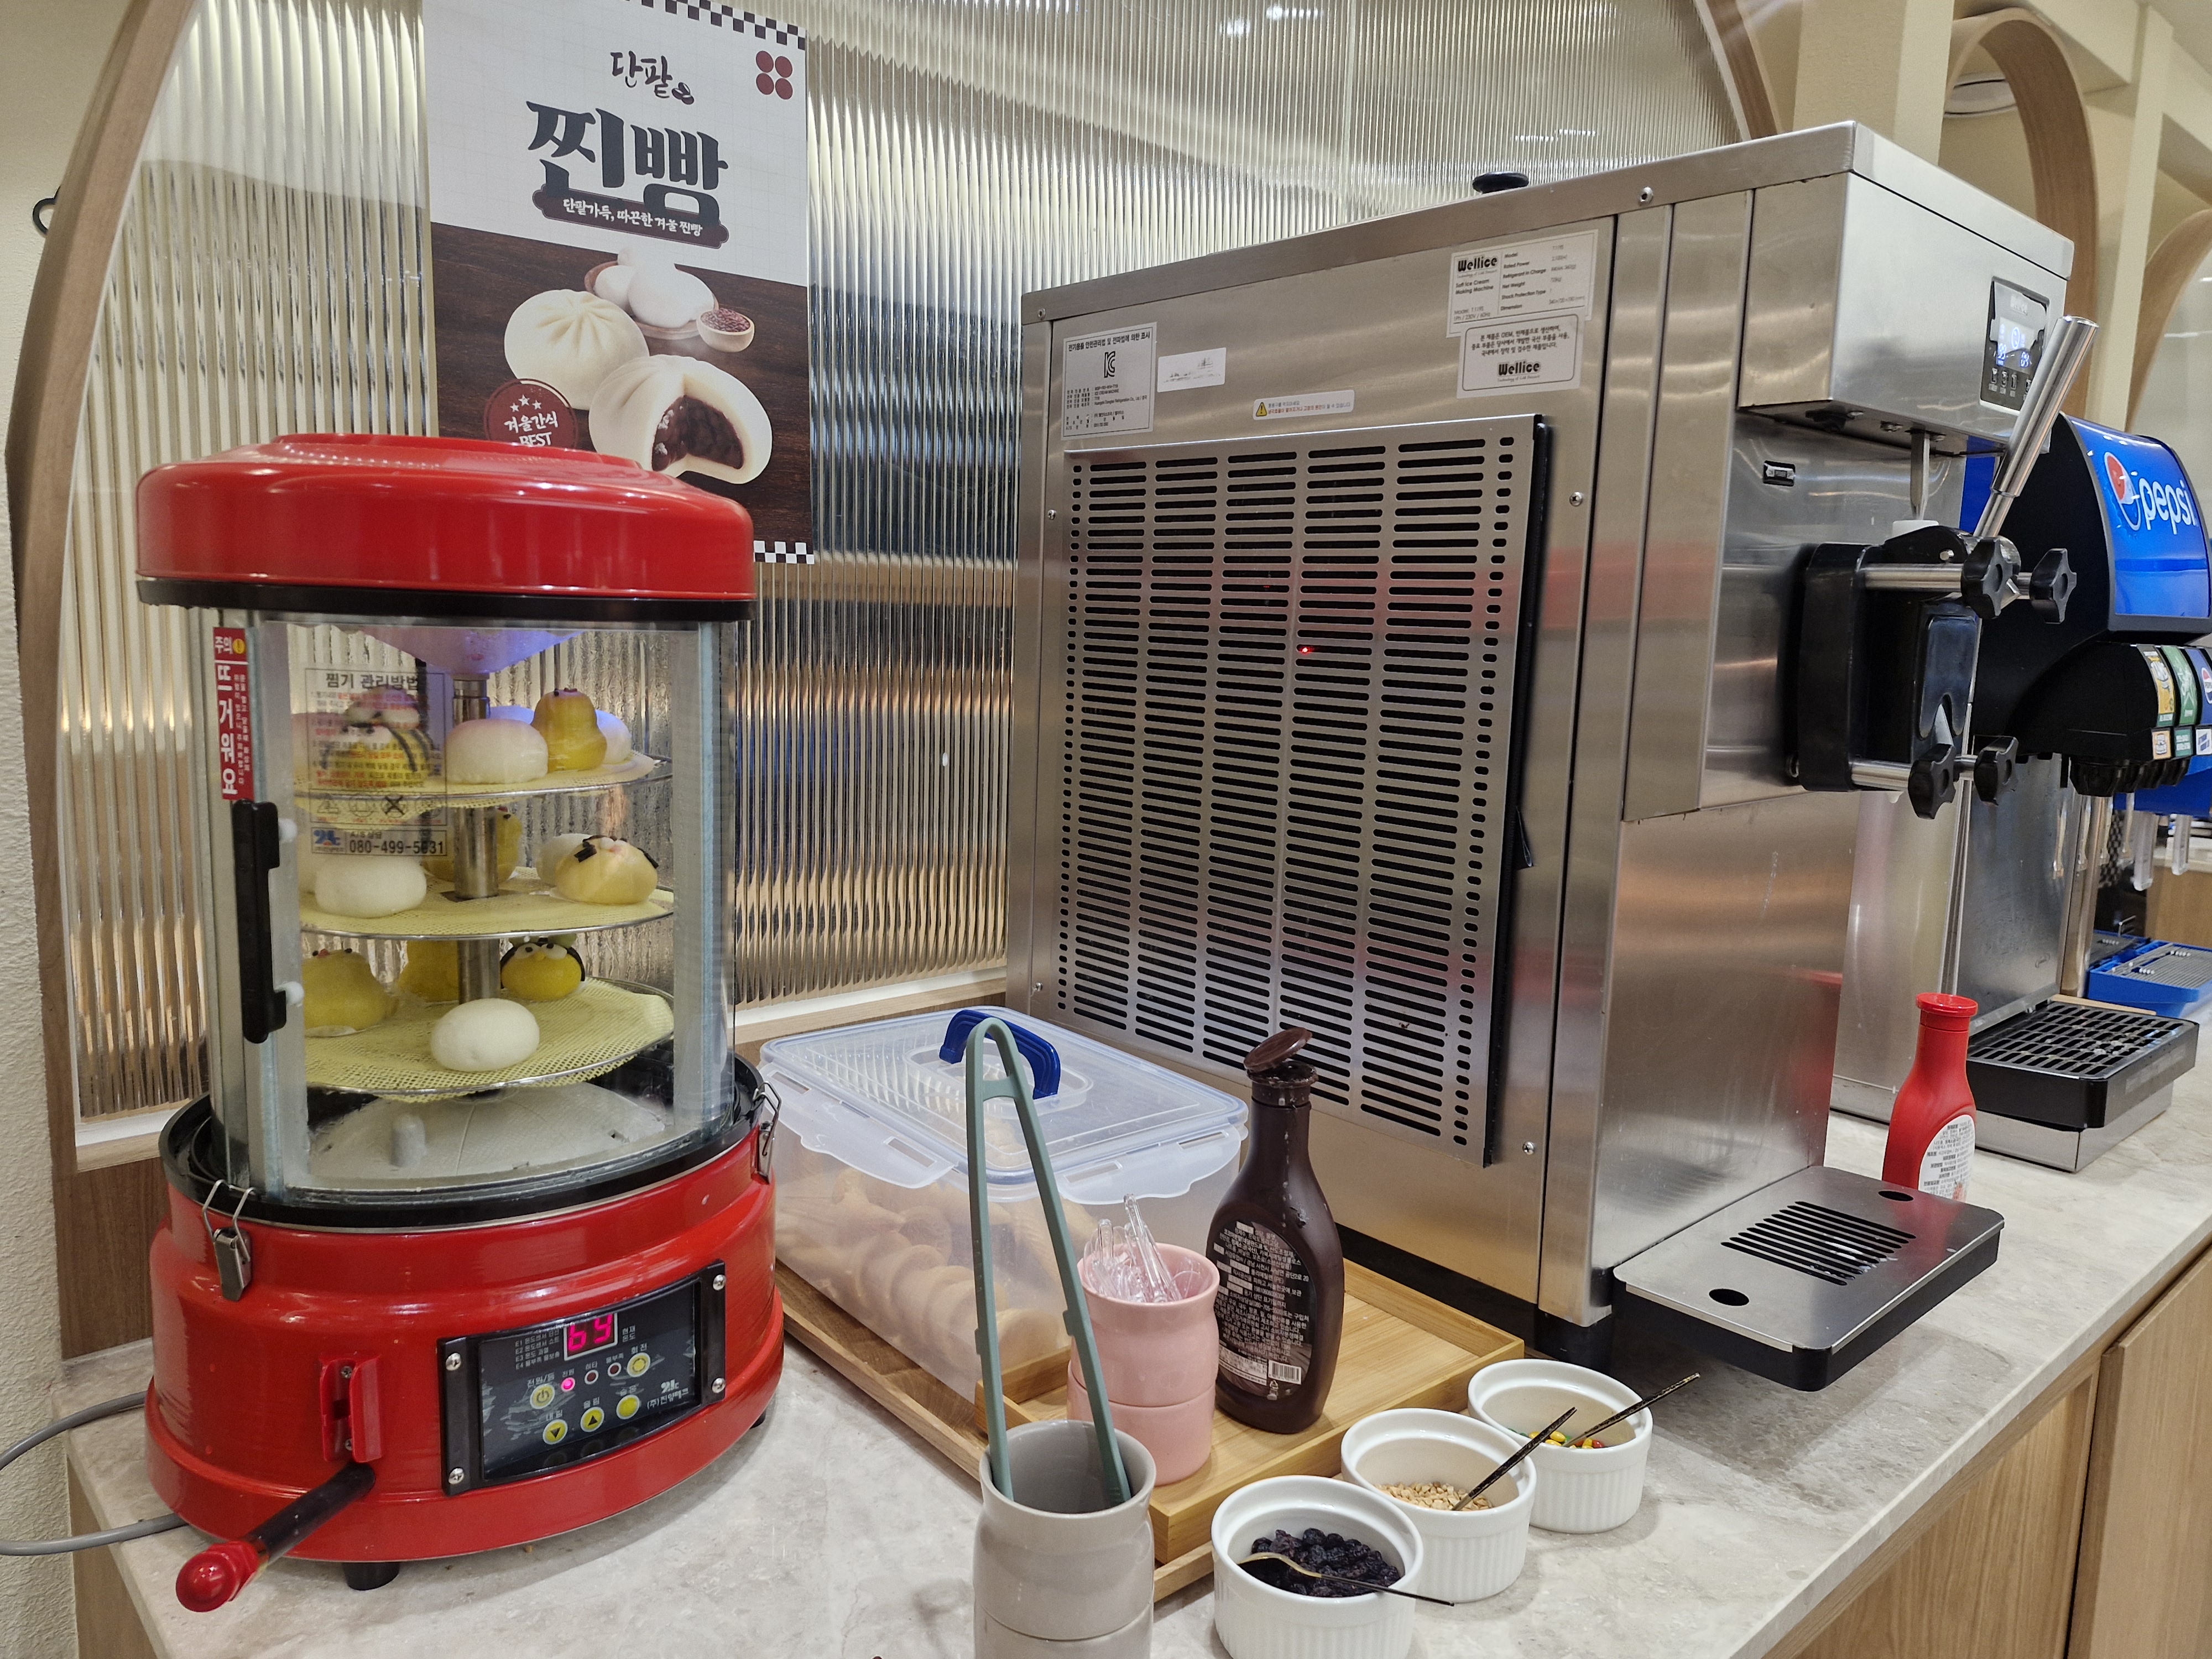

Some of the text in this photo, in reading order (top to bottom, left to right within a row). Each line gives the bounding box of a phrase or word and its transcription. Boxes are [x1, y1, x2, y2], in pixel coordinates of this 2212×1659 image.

[611, 50, 673, 98] 단팥
[526, 101, 729, 226] 찐빵
[563, 198, 703, 237] 단팥가득, 따끈한 겨울 찐빵
[1458, 256, 1498, 272] Wellice
[1086, 338, 1105, 349] 안전관리법
[1131, 332, 1140, 341] 의한
[1498, 361, 1540, 376] Wellice
[504, 411, 559, 434] 겨울간식
[519, 431, 552, 447] BEST
[2139, 478, 2197, 535] pepsi
[215, 636, 233, 654] 주의
[326, 673, 354, 688] 찜기
[217, 665, 238, 795] 뜨거워요
[1247, 1259, 1255, 1267] 경남
[1256, 1262, 1269, 1272] 사천시
[1271, 1266, 1284, 1276] 사남면
[1285, 1270, 1302, 1281] 공단2로
[1253, 1276, 1266, 1286] 피하고
[1292, 1288, 1301, 1297] 보관
[1253, 1292, 1261, 1301] 상단
[622, 1325, 635, 1335] 현재
[1280, 1323, 1300, 1334] 있습니다.
[1291, 1319, 1306, 1329] 사용한
[622, 1333, 635, 1342] 온도
[1281, 1336, 1302, 1347] 있습니다.
[525, 1341, 547, 1351] 온도센서
[527, 1372, 555, 1386] 전원/등
